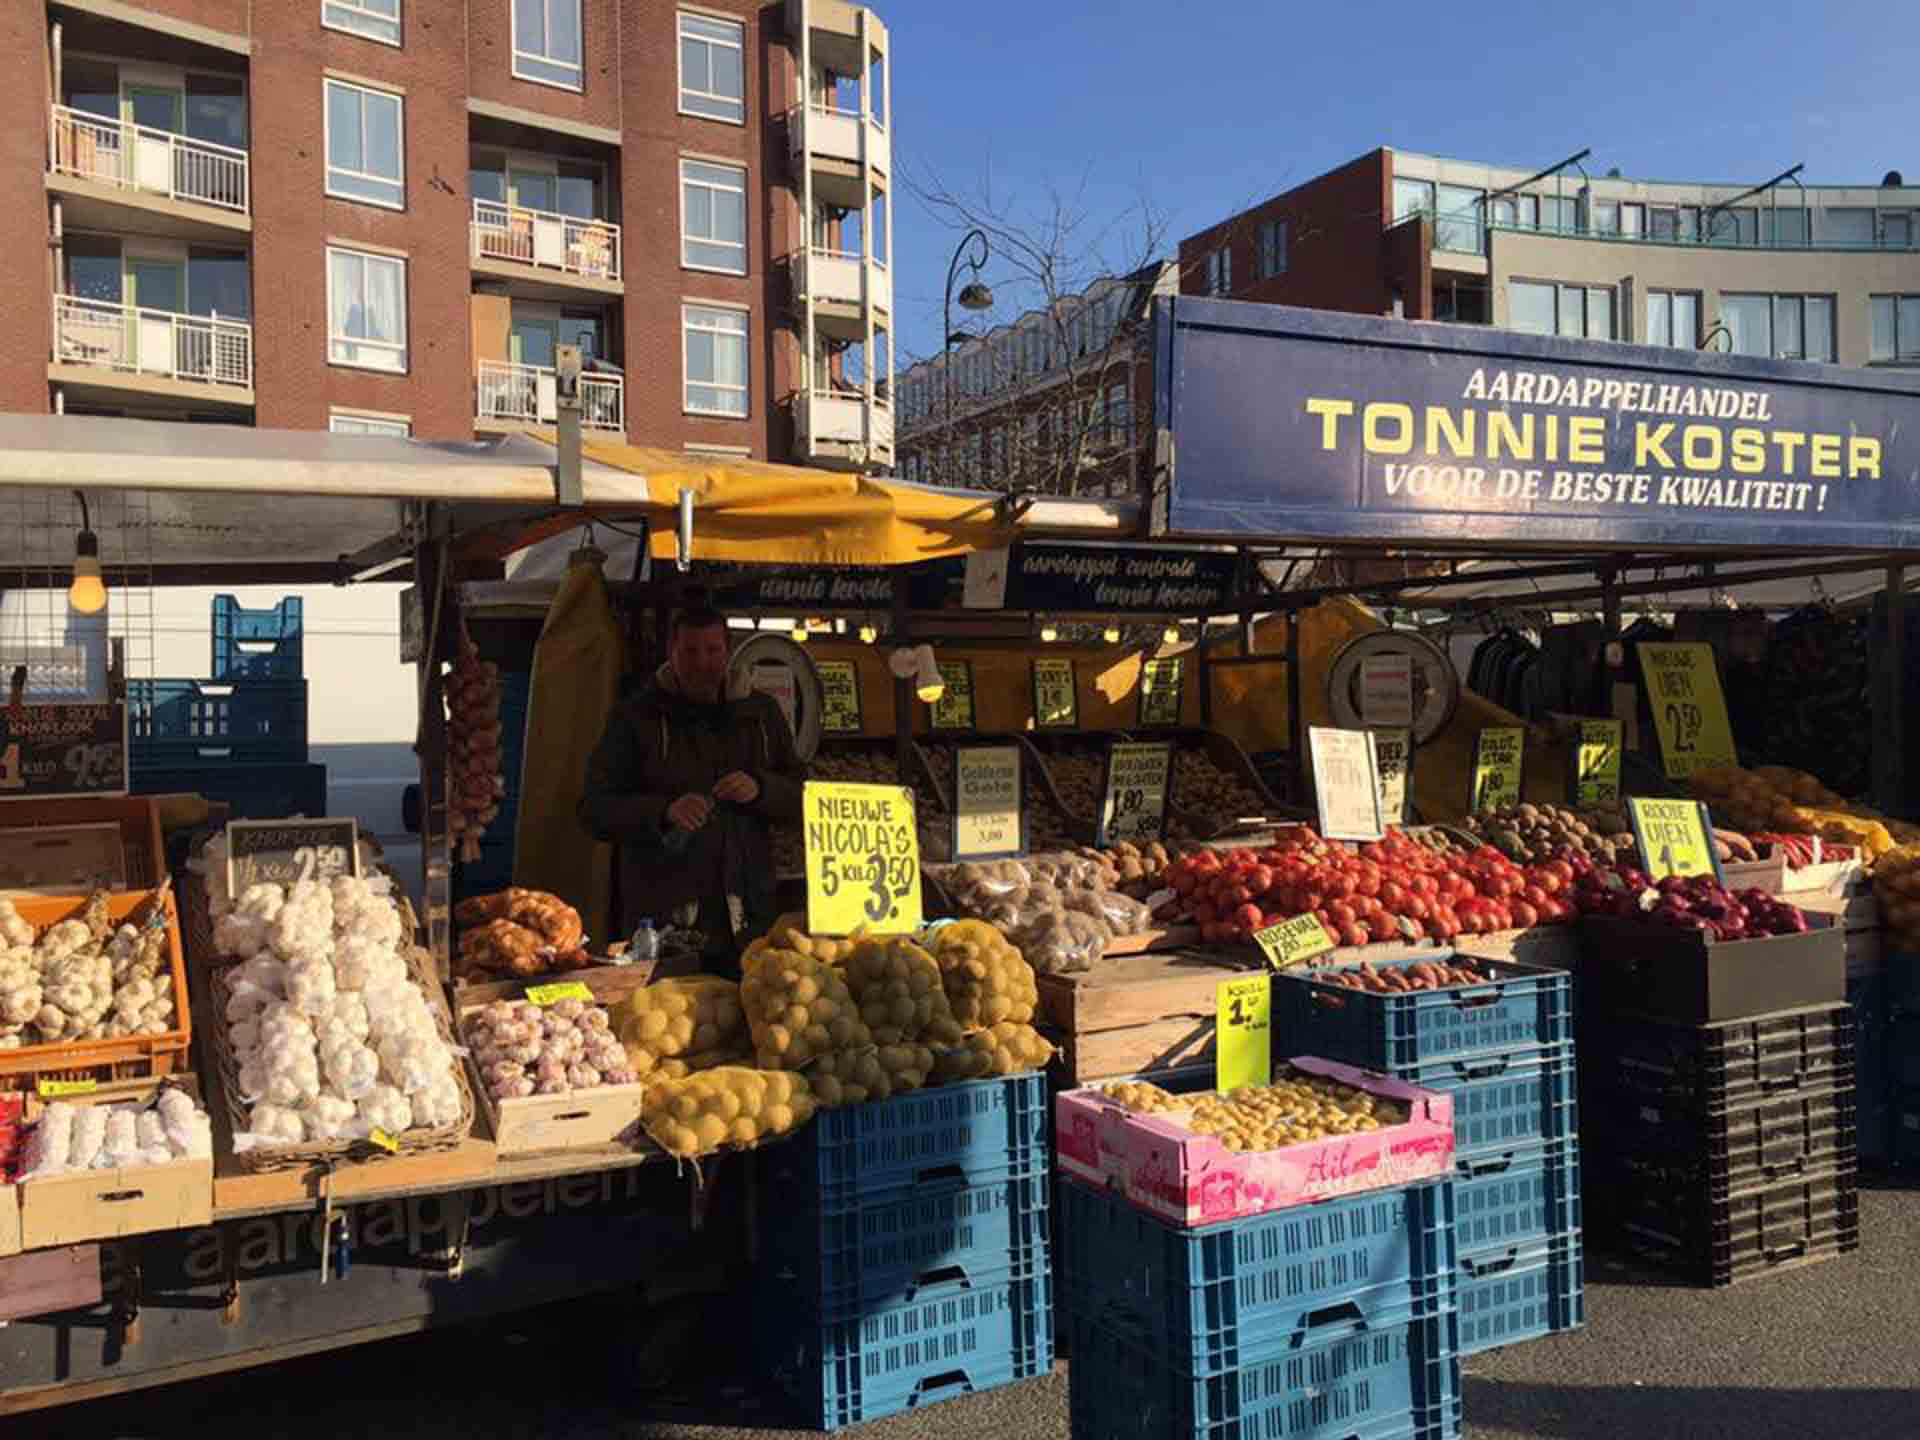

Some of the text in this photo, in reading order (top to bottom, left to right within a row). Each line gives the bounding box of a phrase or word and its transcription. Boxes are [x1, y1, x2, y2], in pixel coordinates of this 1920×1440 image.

[1463, 368, 1772, 420] AARDAPPELHANDEL
[1306, 396, 1881, 480] TONNIE KOSTER
[1383, 463, 1482, 496] VOOR
[1496, 468, 1542, 499] DE
[1551, 471, 1650, 503] BESTE
[1657, 475, 1813, 510] KWALITEIT
[817, 796, 894, 822] NIEUWE
[808, 821, 912, 856] NICOLA'S
[820, 855, 839, 897] 5
